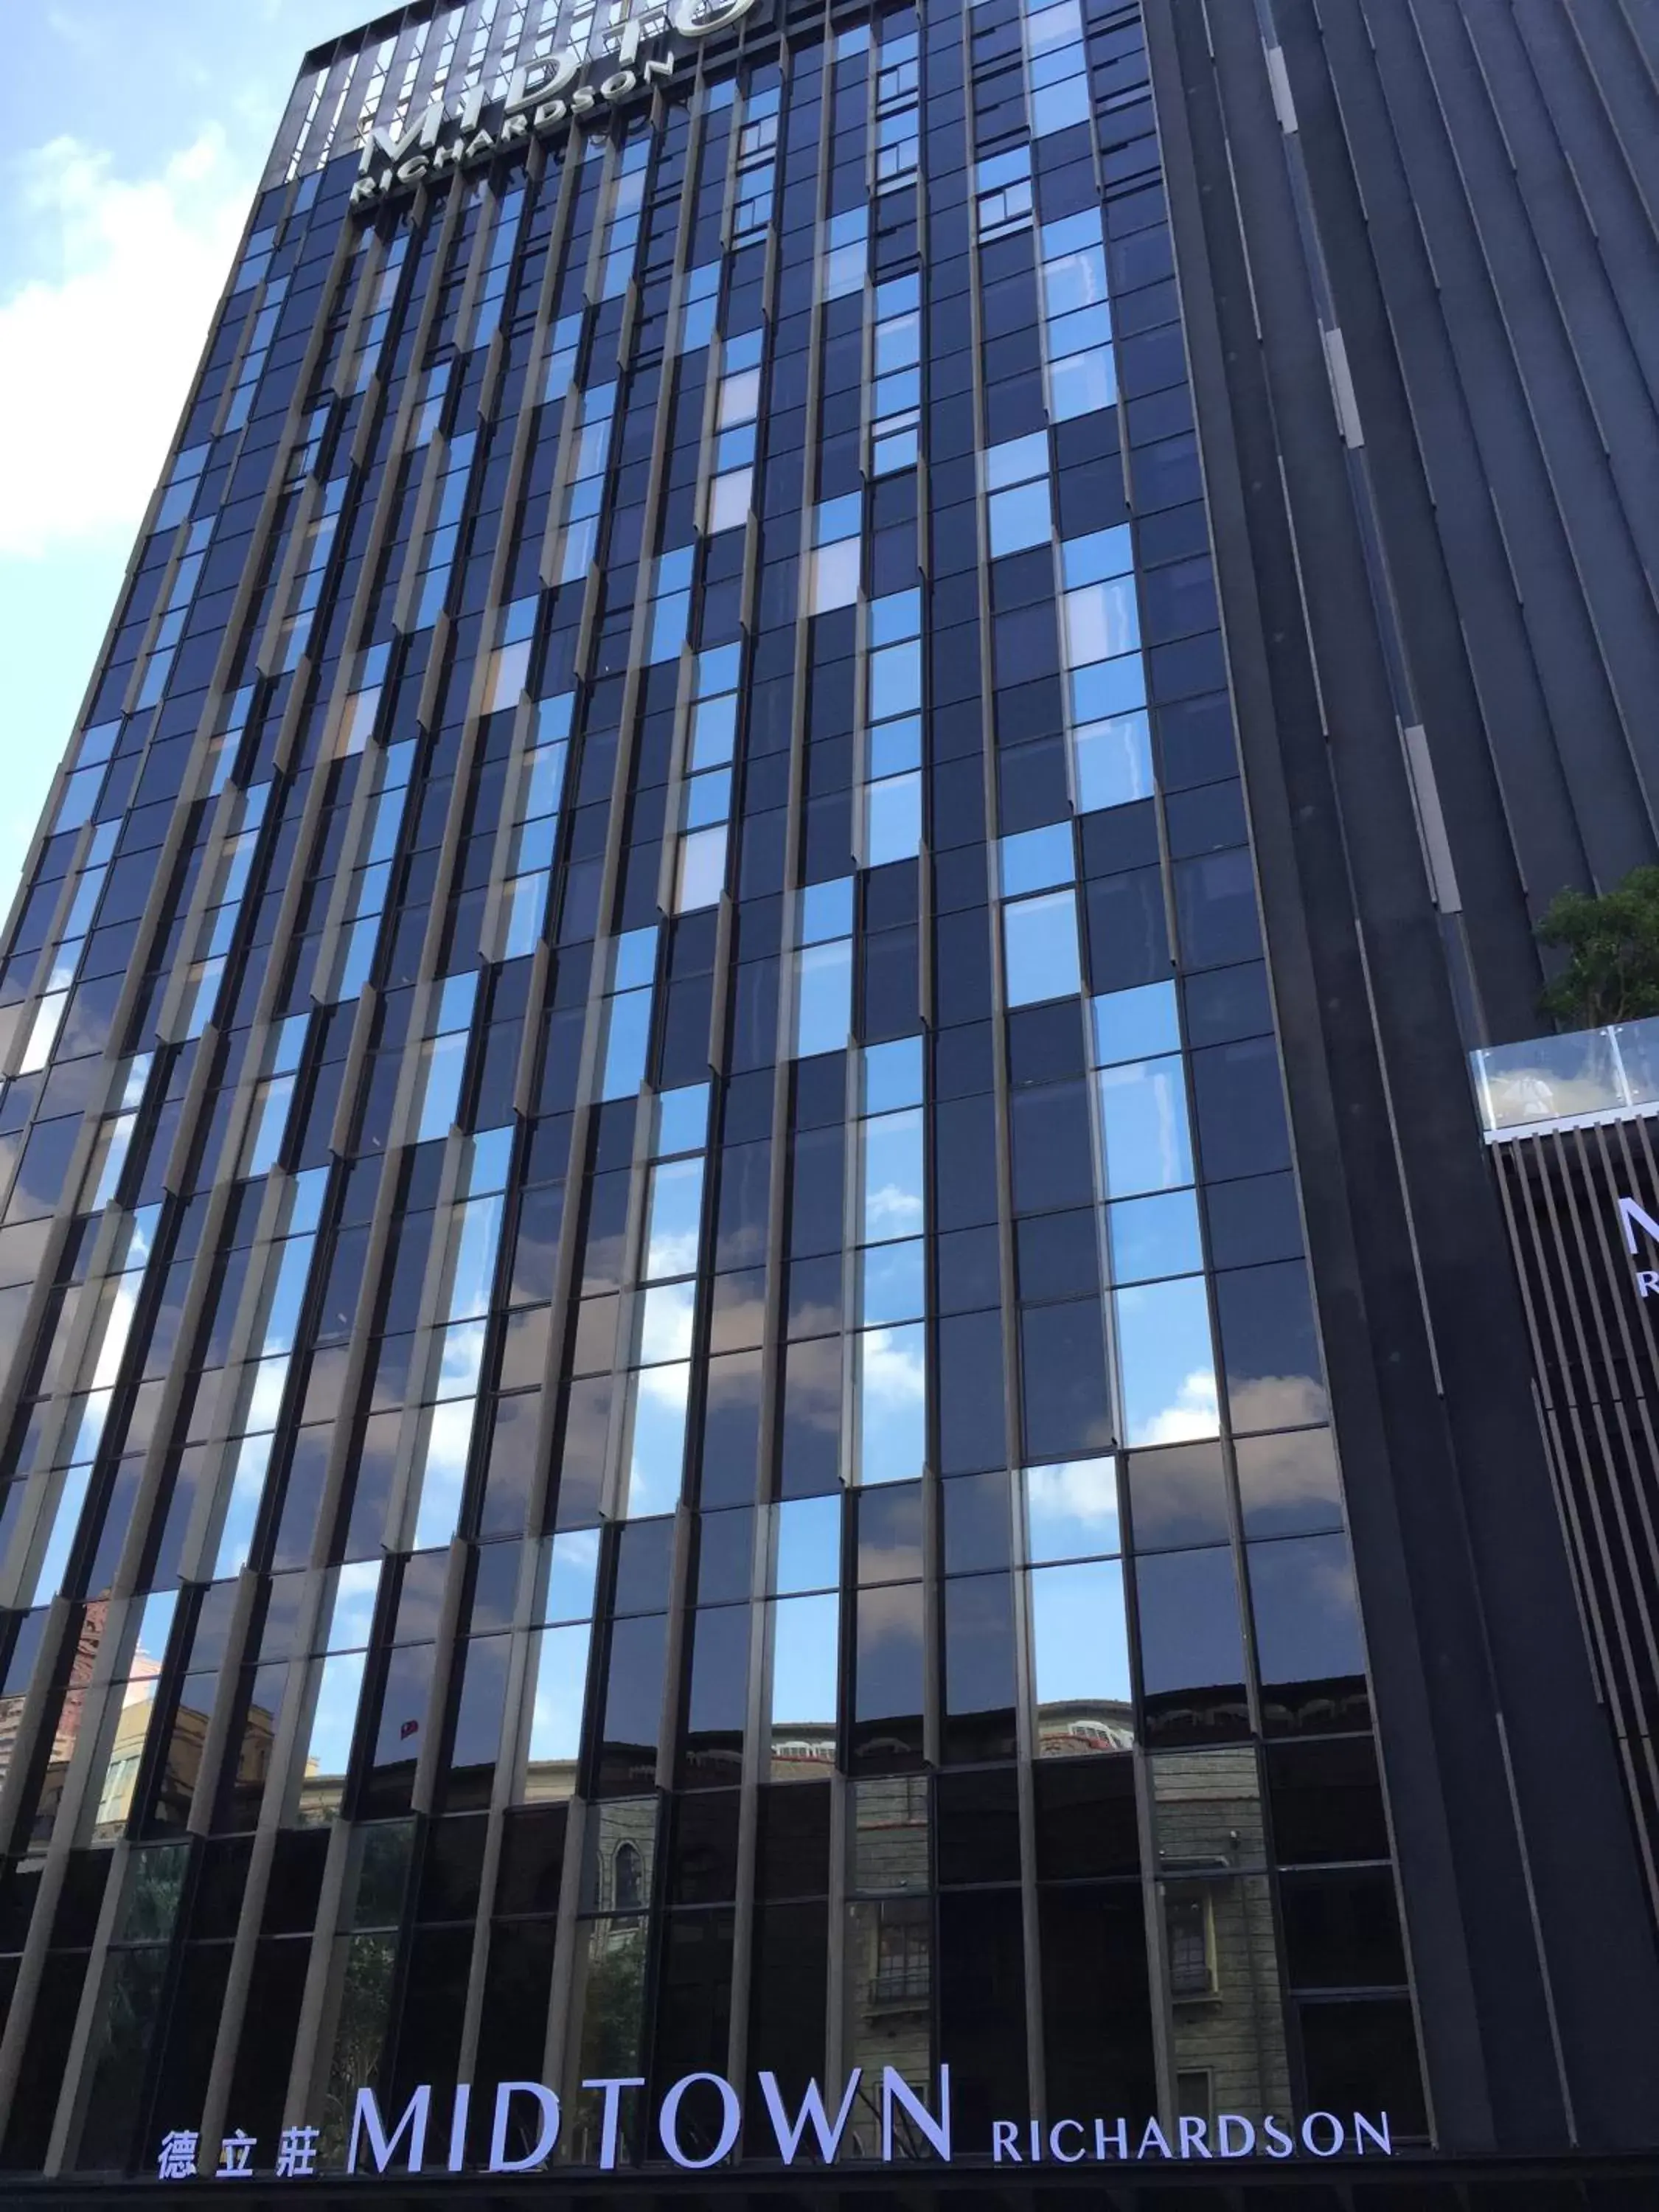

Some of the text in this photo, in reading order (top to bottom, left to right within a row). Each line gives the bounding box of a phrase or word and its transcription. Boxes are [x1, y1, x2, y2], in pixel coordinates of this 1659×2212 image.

[349, 50, 675, 205] RICHARDSON
[157, 2126, 320, 2180] 德立莊
[347, 2063, 1392, 2174] MIDTOWN RICHARDSON
